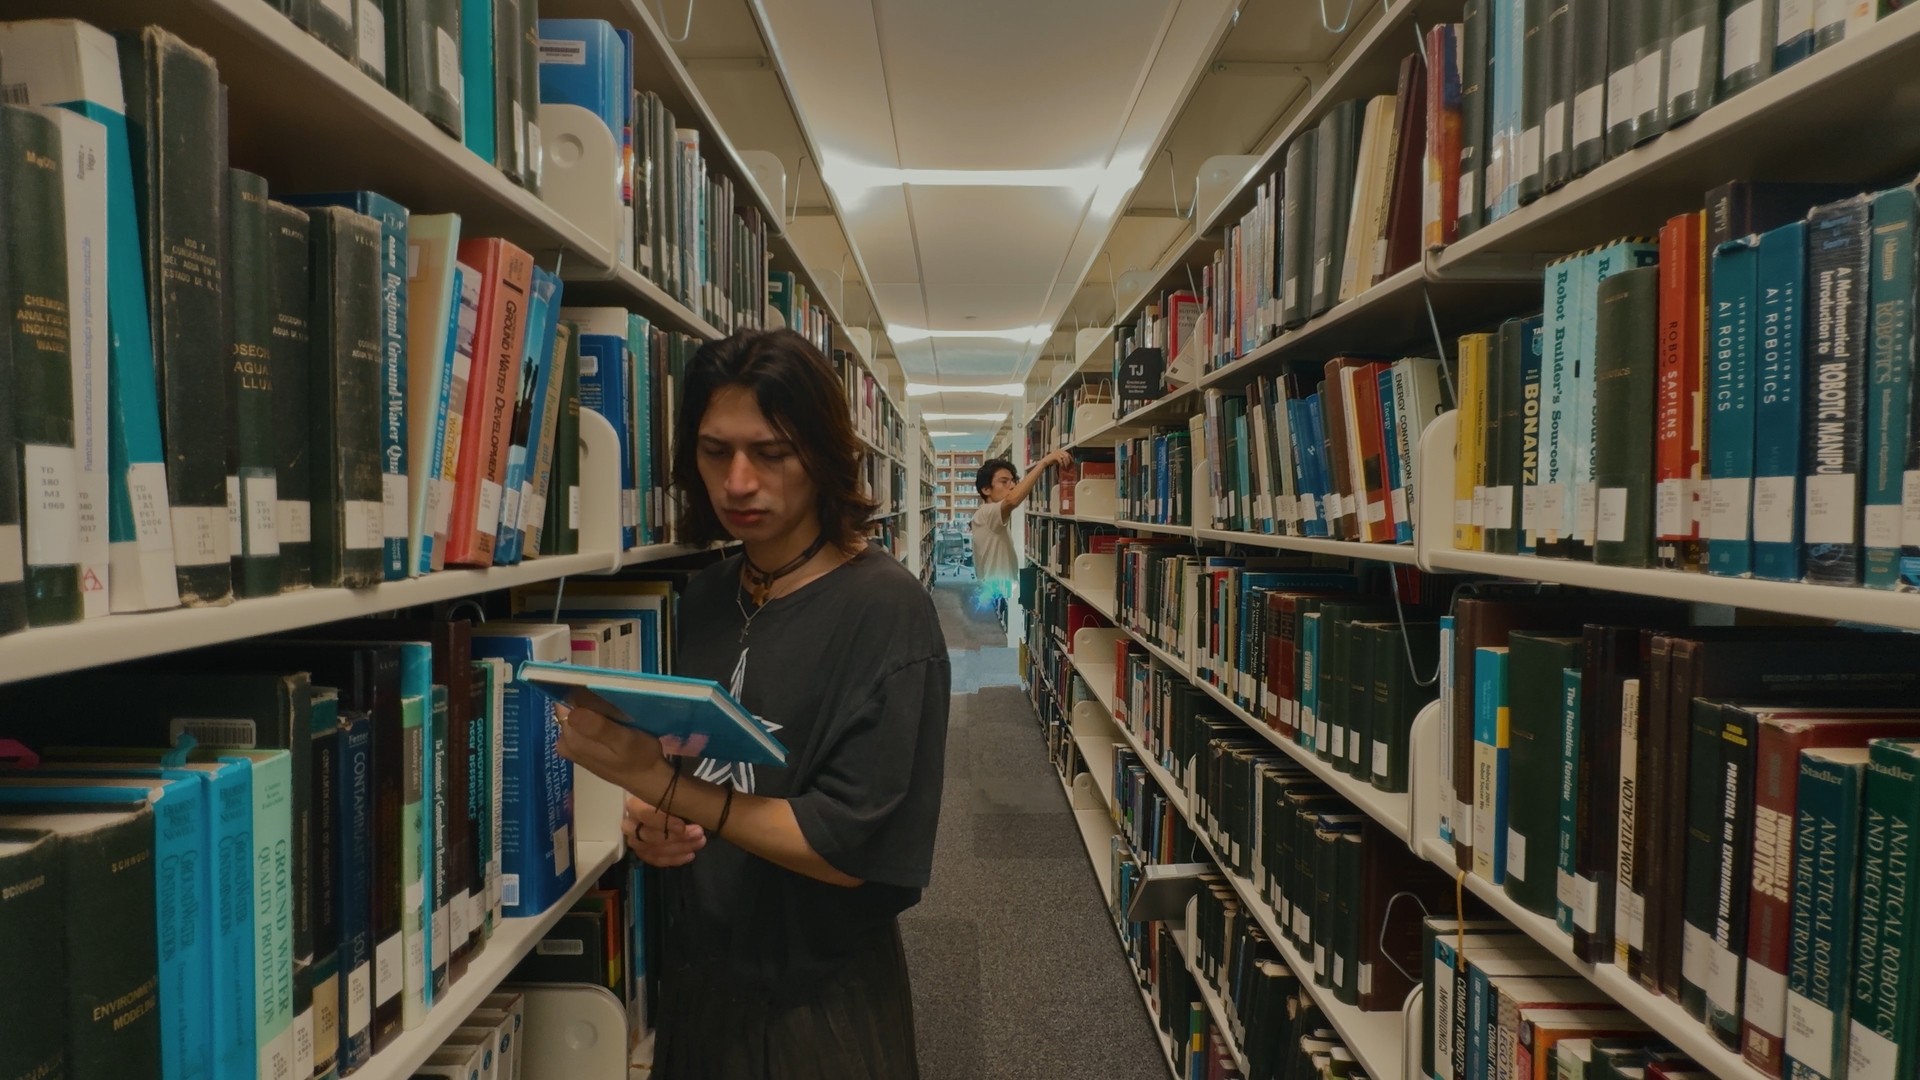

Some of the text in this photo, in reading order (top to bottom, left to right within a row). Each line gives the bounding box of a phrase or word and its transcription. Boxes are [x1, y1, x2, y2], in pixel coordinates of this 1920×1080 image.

[383, 272, 401, 339] Regional
[500, 300, 518, 351] GROUND
[1555, 269, 1568, 322] Robot
[1817, 270, 1836, 354] Introduction to
[1834, 267, 1853, 358] A Mathematical
[495, 354, 511, 394] WATER
[1129, 365, 1144, 376] TJ
[1552, 326, 1566, 405] Builder's
[1717, 301, 1732, 412] AI ROBOTICS
[1737, 296, 1747, 410] INTRODUCTION TO
[1763, 288, 1779, 404] AI ROBOTICS
[1782, 281, 1793, 402] INTRODUCTION TO
[1874, 302, 1895, 384] ROBOTICS
[388, 340, 402, 443] Ground-Water
[1383, 401, 1392, 431] Energy
[1667, 320, 1678, 439] ROBO SAPIENS
[1817, 363, 1848, 421] ROBOTIC
[487, 397, 506, 482] DEVELOPMENT
[1395, 373, 1405, 411] ENERGY
[1400, 414, 1413, 480] CONVERSION
[1522, 383, 1540, 485] BONANZ
[41, 466, 54, 475] TD
[1565, 710, 1576, 758] Robotics
[1567, 687, 1576, 707] The
[435, 751, 444, 793] Economics
[477, 717, 485, 808] GROUNDWATER
[1563, 760, 1574, 801] Review
[1724, 762, 1738, 820] PRACTICAL
[1800, 763, 1843, 785] Stadler
[1867, 760, 1916, 782] Stadler
[435, 799, 445, 847] Groundwater
[1723, 821, 1735, 843] AND
[1752, 804, 1778, 896] ROBOTICS
[1800, 808, 1816, 851] AND
[436, 849, 446, 897] Remediation
[1719, 843, 1735, 918] EXPERIMENTAL
[1815, 816, 1838, 932] ANALYTICAL
[1856, 808, 1885, 1005] AND MECHATRONICS
[258, 846, 276, 1026] QUALITY PROTECTION
[275, 839, 290, 1016] GROUND WATER
[1791, 854, 1814, 999] MECHATRONICS
[1875, 815, 1909, 1041] ANALYTICAL ROBOTICS
[1437, 985, 1447, 1057] AMPHIBIONICS
[1454, 976, 1467, 1074] COMBAT ROBOTS
[1487, 1022, 1496, 1052] COMBAT
[1498, 1025, 1509, 1055] LEGO
